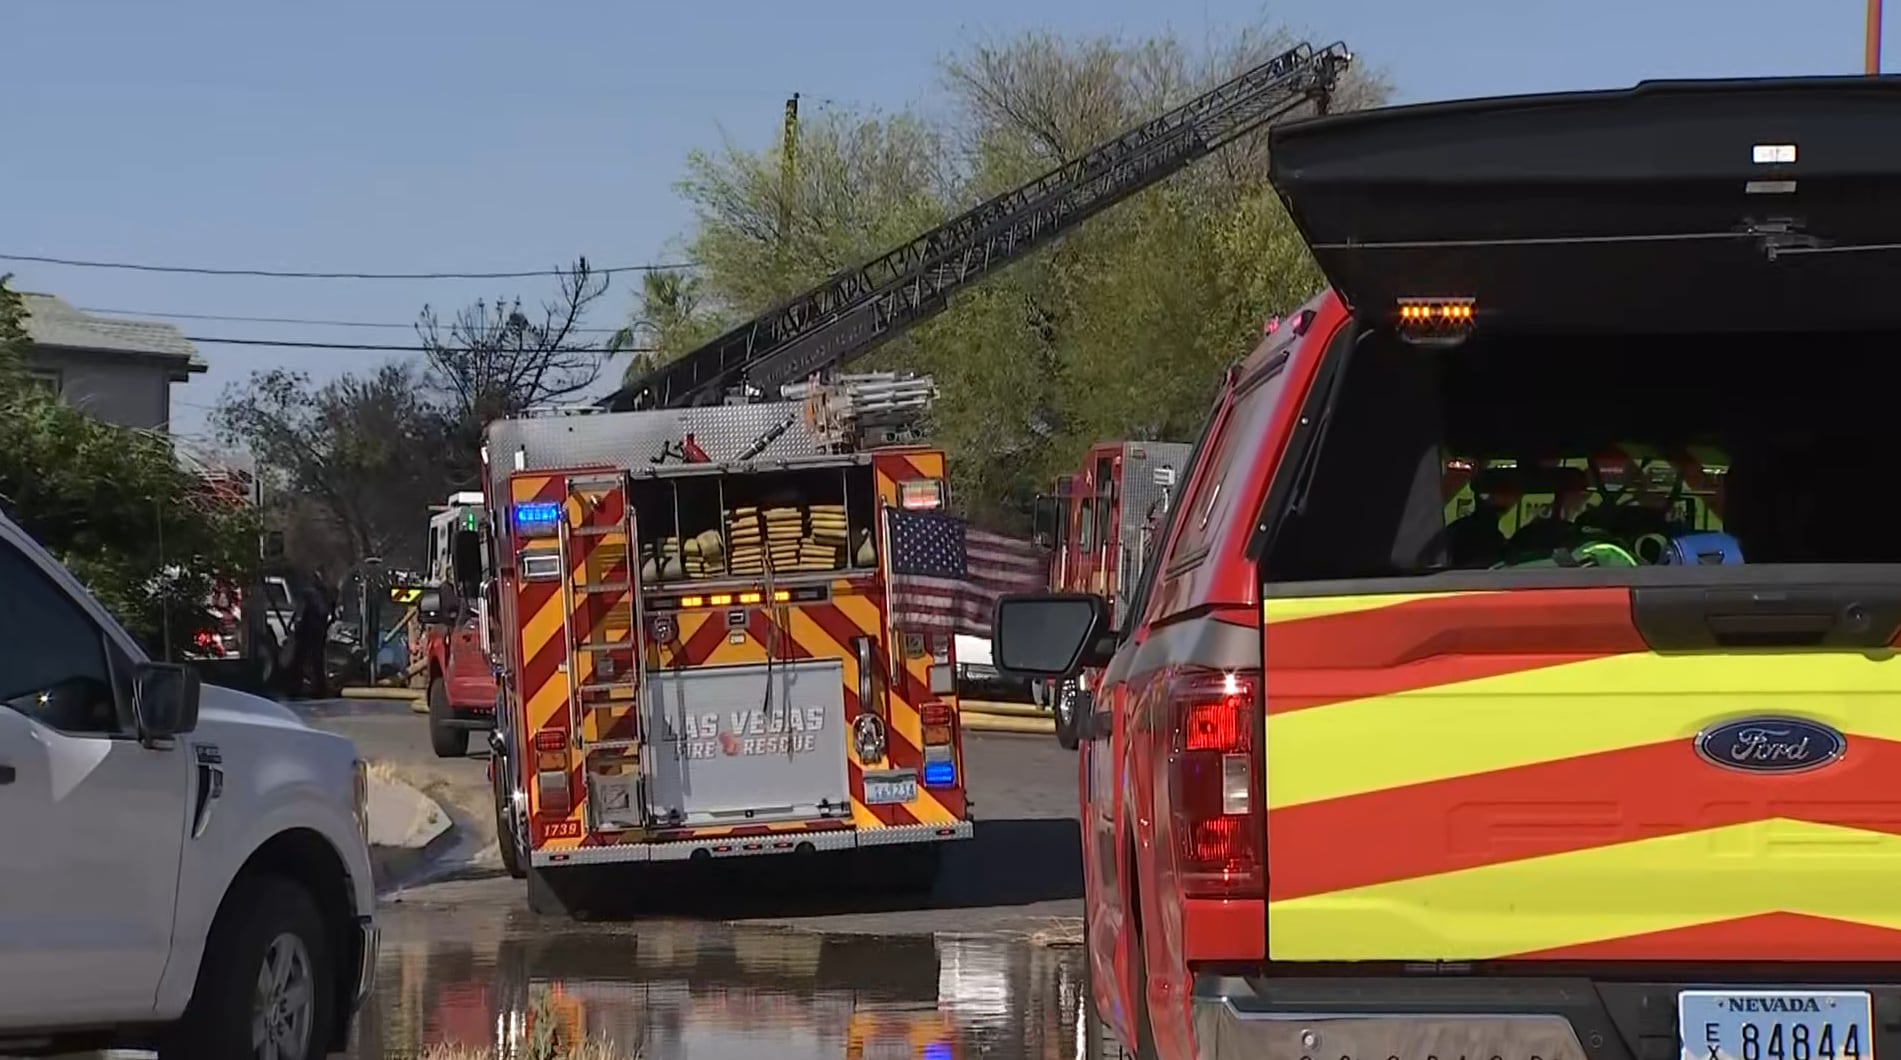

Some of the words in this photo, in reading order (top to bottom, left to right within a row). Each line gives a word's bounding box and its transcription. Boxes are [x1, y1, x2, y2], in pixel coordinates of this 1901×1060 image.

[731, 706, 826, 736] VEGAS
[744, 735, 815, 756] RESCUE
[1731, 727, 1809, 760] Ford
[545, 823, 577, 837] 1739
[1729, 998, 1820, 1013] NEVADA
[1742, 1023, 1861, 1060] 84844
